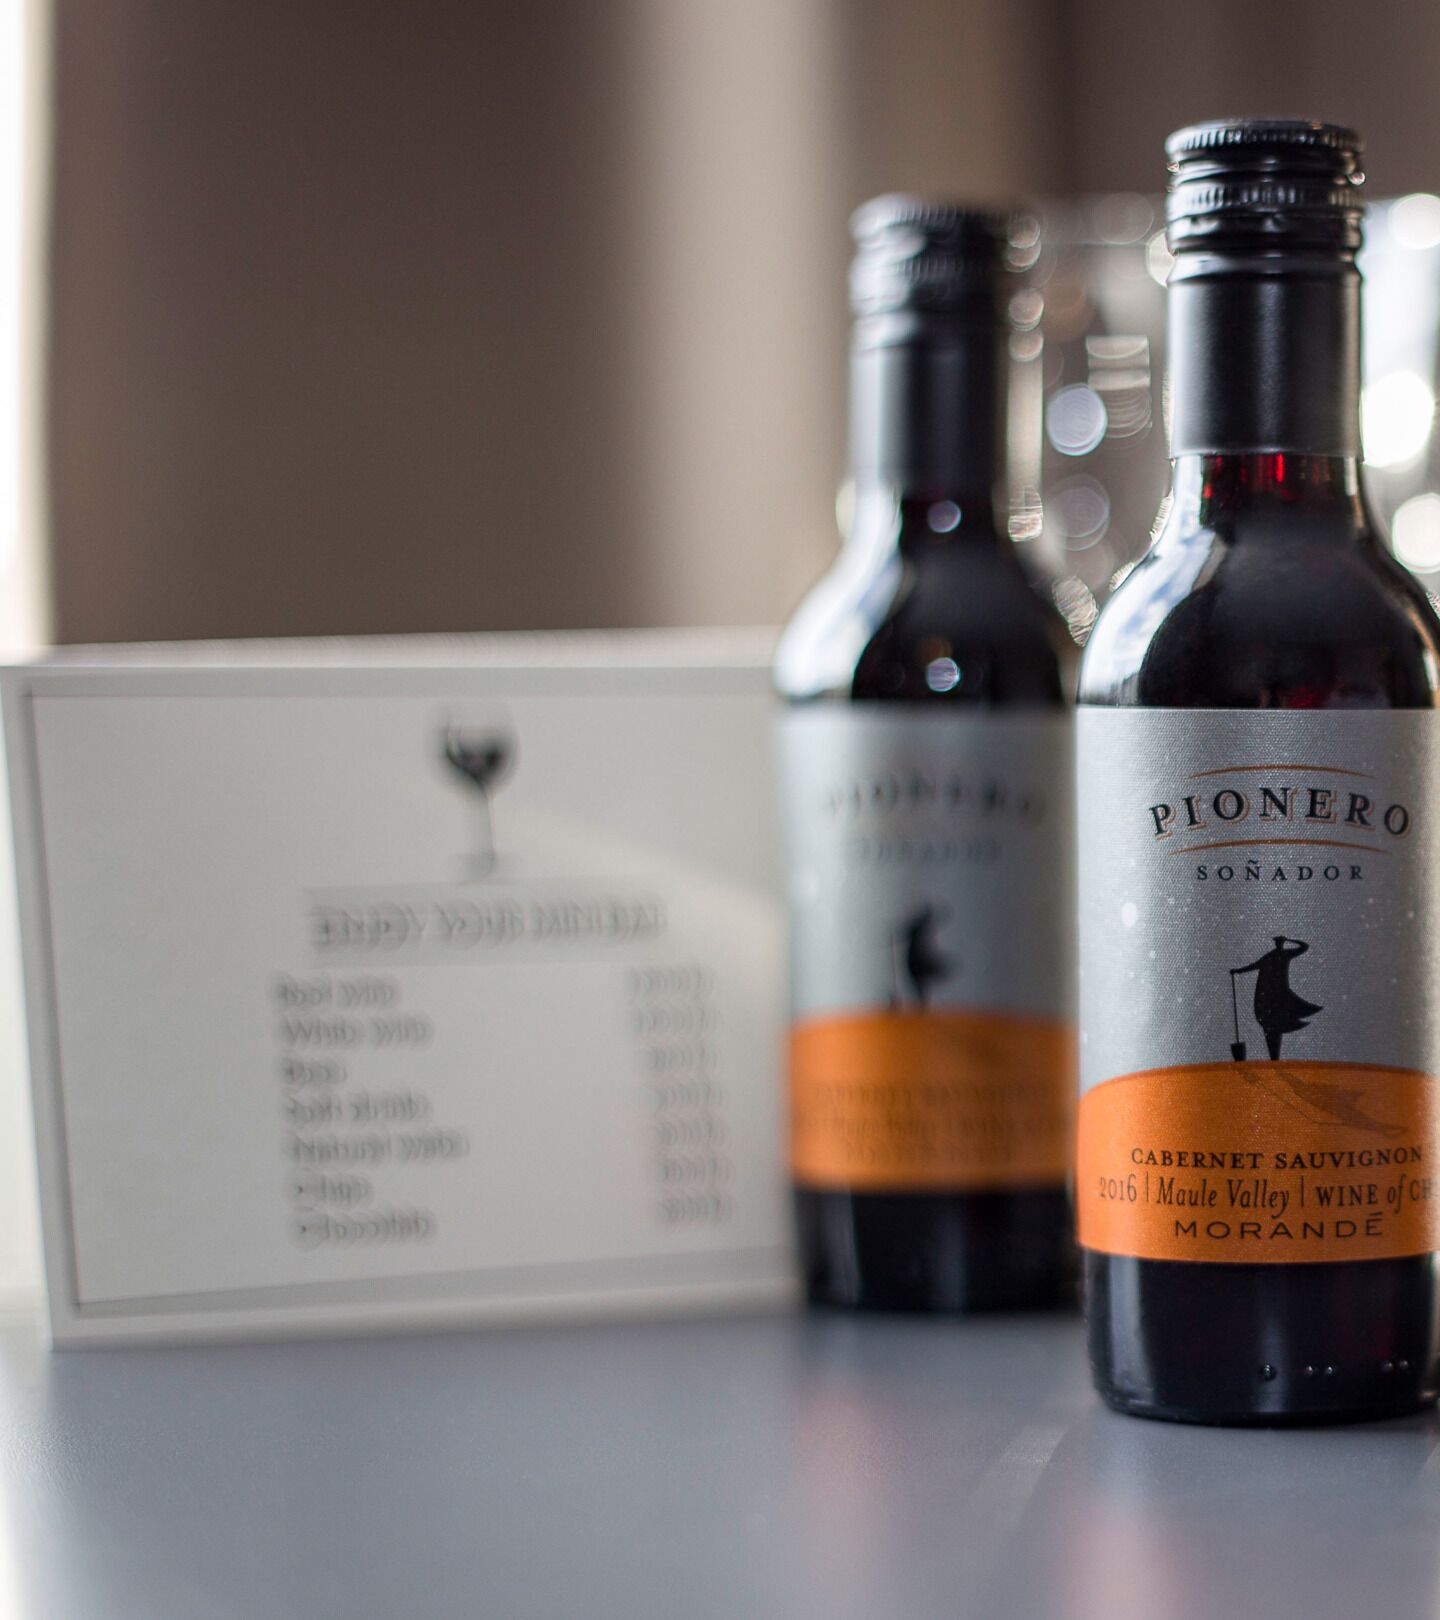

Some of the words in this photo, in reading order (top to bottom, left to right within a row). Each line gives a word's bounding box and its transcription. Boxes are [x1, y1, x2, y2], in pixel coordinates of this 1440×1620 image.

[1149, 786, 1412, 841] PIONERO
[1197, 860, 1364, 882] SOÑADOR
[1131, 1147, 1263, 1170] CABERNET
[1275, 1145, 1423, 1170] SAUVIGNON
[1100, 1172, 1138, 1203] 2016
[1156, 1176, 1218, 1208] Maule
[1227, 1177, 1290, 1220] Valley
[1315, 1183, 1379, 1208] WINE
[1387, 1173, 1407, 1215] of
[1174, 1211, 1384, 1240] MORANDÉ
